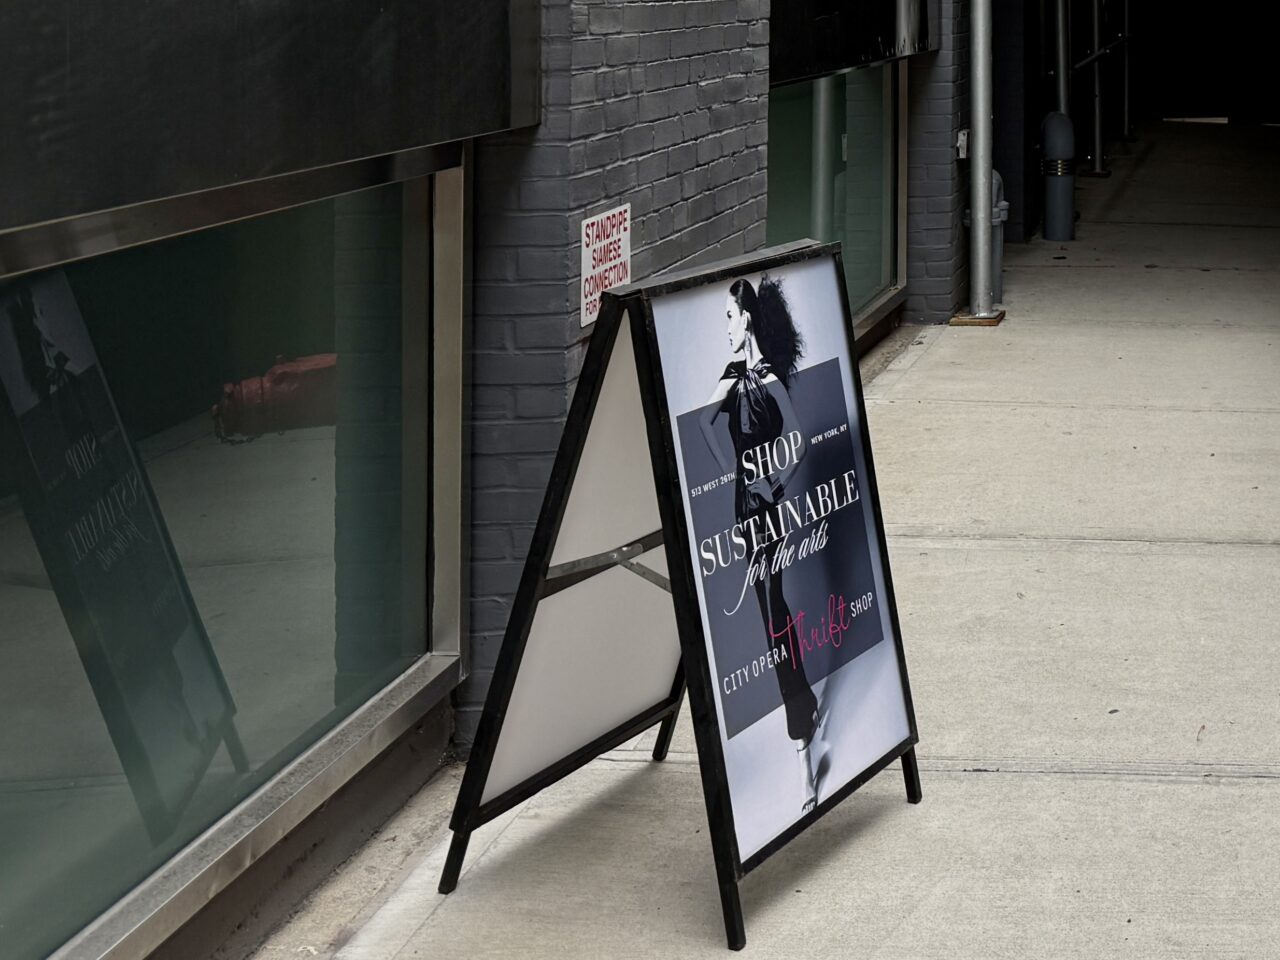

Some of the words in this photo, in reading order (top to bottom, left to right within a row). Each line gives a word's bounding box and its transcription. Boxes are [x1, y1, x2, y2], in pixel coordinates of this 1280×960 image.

[585, 208, 628, 248] STANDPIPE
[592, 237, 622, 270] SIAMESE
[583, 259, 628, 299] CONNECTION
[585, 298, 598, 317] FOR
[810, 434, 823, 445] NEW
[824, 429, 840, 440] YORK,
[840, 423, 848, 432] NY
[742, 430, 802, 486] SHOP
[691, 486, 702, 497] 513
[702, 479, 719, 493] WEST
[720, 472, 736, 485] 26TH
[700, 469, 860, 577] SUSTAINABLE
[723, 544, 768, 616] for
[771, 530, 796, 574] the
[798, 520, 829, 561] arts
[850, 592, 874, 617] SHOP
[768, 594, 851, 670] Thrift
[752, 643, 788, 677] OPERA
[723, 665, 750, 695] CITY
